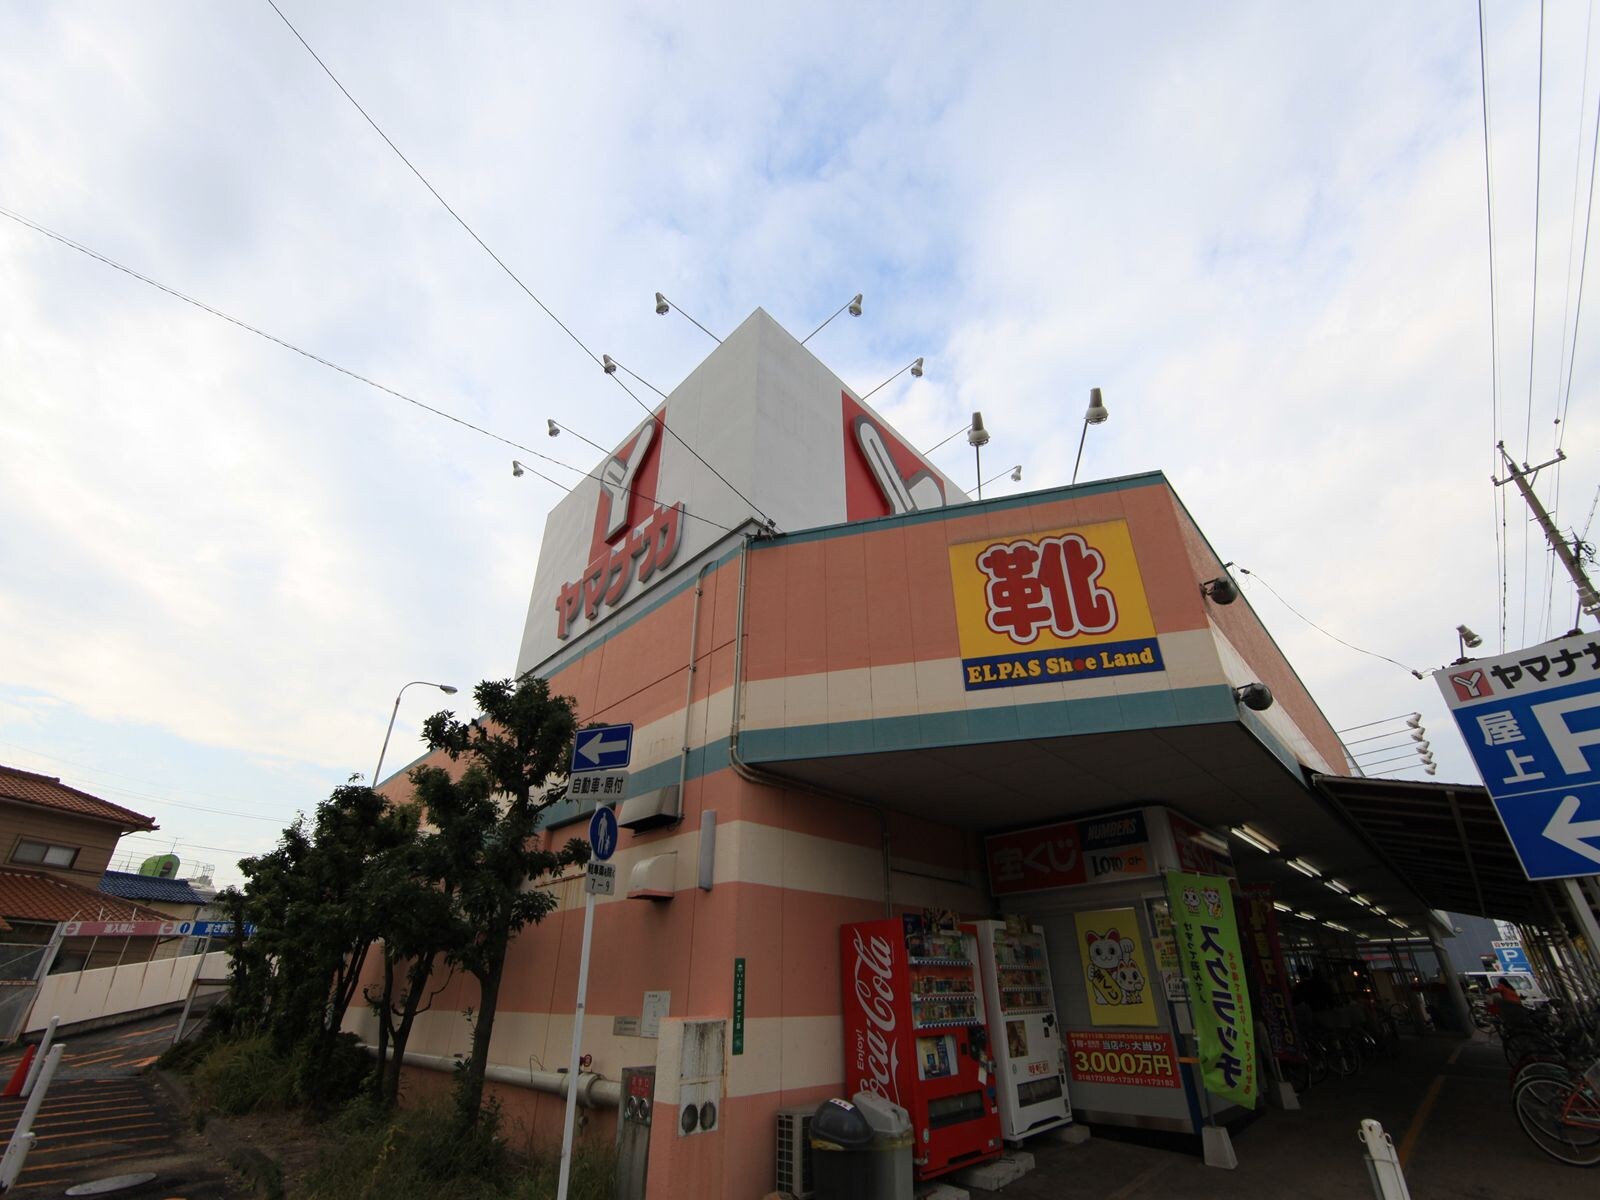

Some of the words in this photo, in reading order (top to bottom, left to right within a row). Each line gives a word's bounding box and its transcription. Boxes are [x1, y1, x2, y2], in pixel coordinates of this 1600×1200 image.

[556, 501, 685, 640] ヤマナカ
[976, 533, 1119, 645] 靴
[967, 659, 1041, 684] ELPAS
[1046, 656, 1097, 675] Shoe
[1099, 647, 1154, 668] Land
[1476, 710, 1546, 784] 屋上
[571, 776, 624, 794] 自動車・原付
[1088, 817, 1137, 841] NUMBERS
[1502, 949, 1518, 961] P
[856, 1029, 864, 1070] Enjoy!
[1074, 1051, 1173, 1076] 3,000万円
